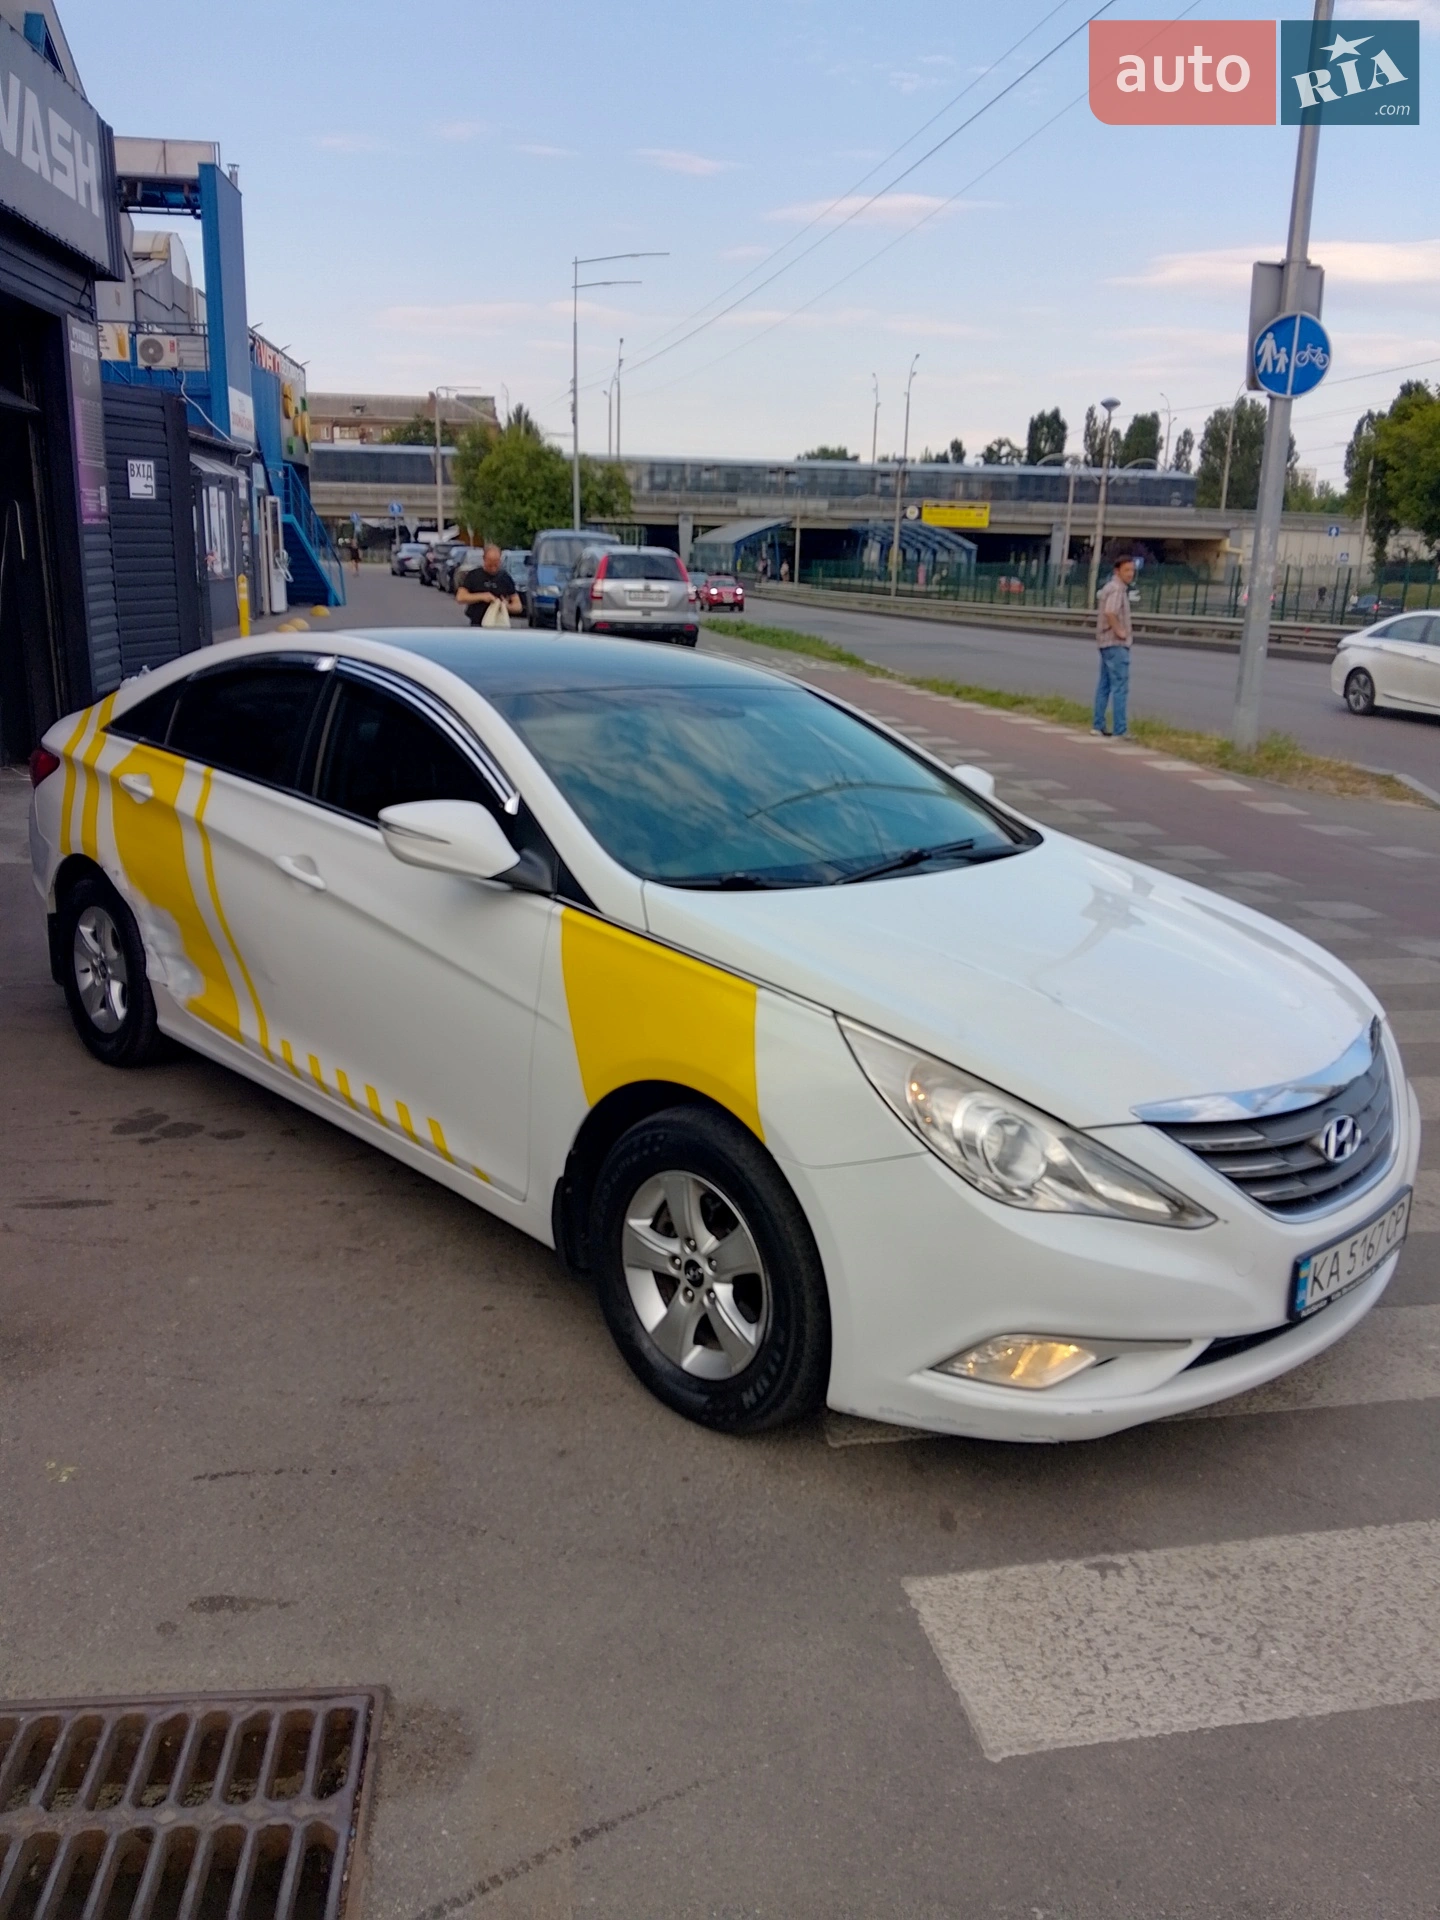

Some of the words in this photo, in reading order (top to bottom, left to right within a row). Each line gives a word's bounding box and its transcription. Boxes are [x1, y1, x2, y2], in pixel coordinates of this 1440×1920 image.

[129, 463, 153, 482] ВХІД
[1310, 1251, 1340, 1297] KA
[1347, 1219, 1385, 1275] 5167
[1386, 1202, 1405, 1243] CP
